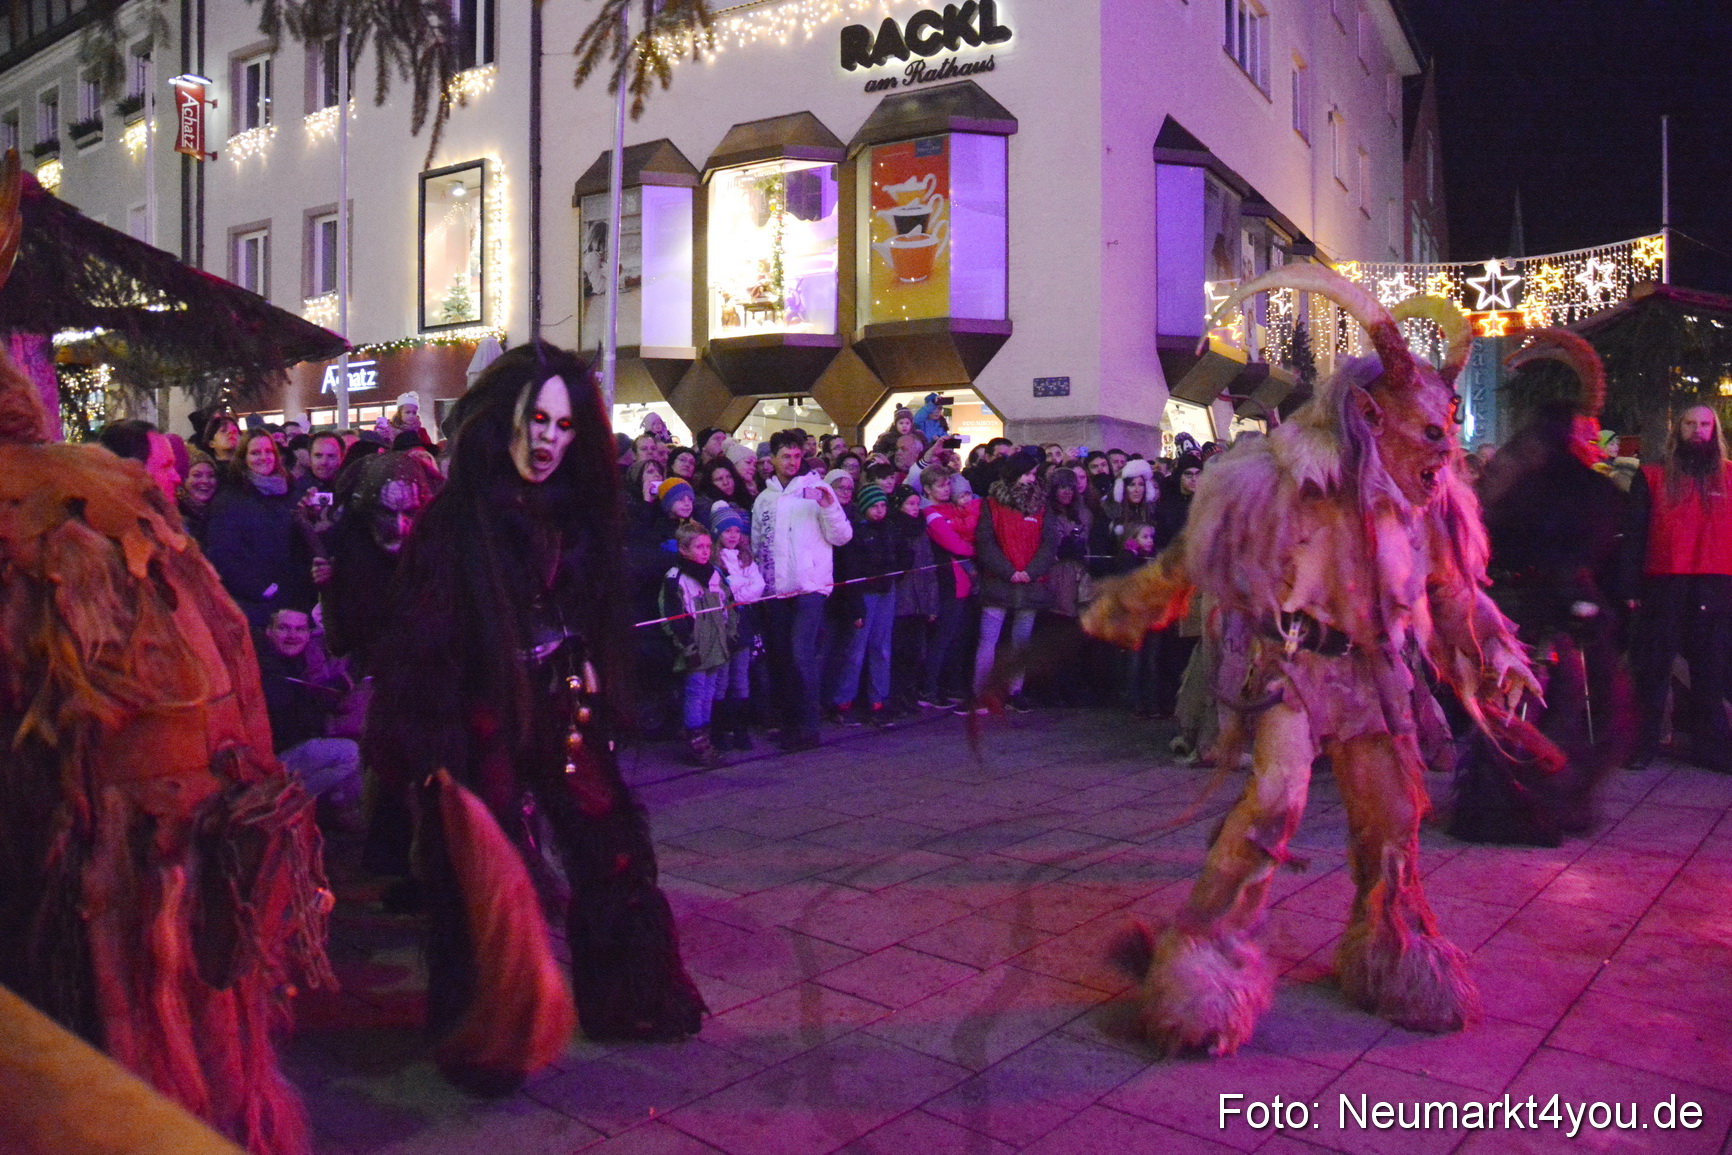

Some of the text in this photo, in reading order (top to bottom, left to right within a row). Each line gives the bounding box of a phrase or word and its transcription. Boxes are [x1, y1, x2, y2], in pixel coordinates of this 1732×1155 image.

[840, 0, 1013, 71] RACKL
[864, 54, 996, 93] am Rathaus
[181, 90, 200, 151] Achatz
